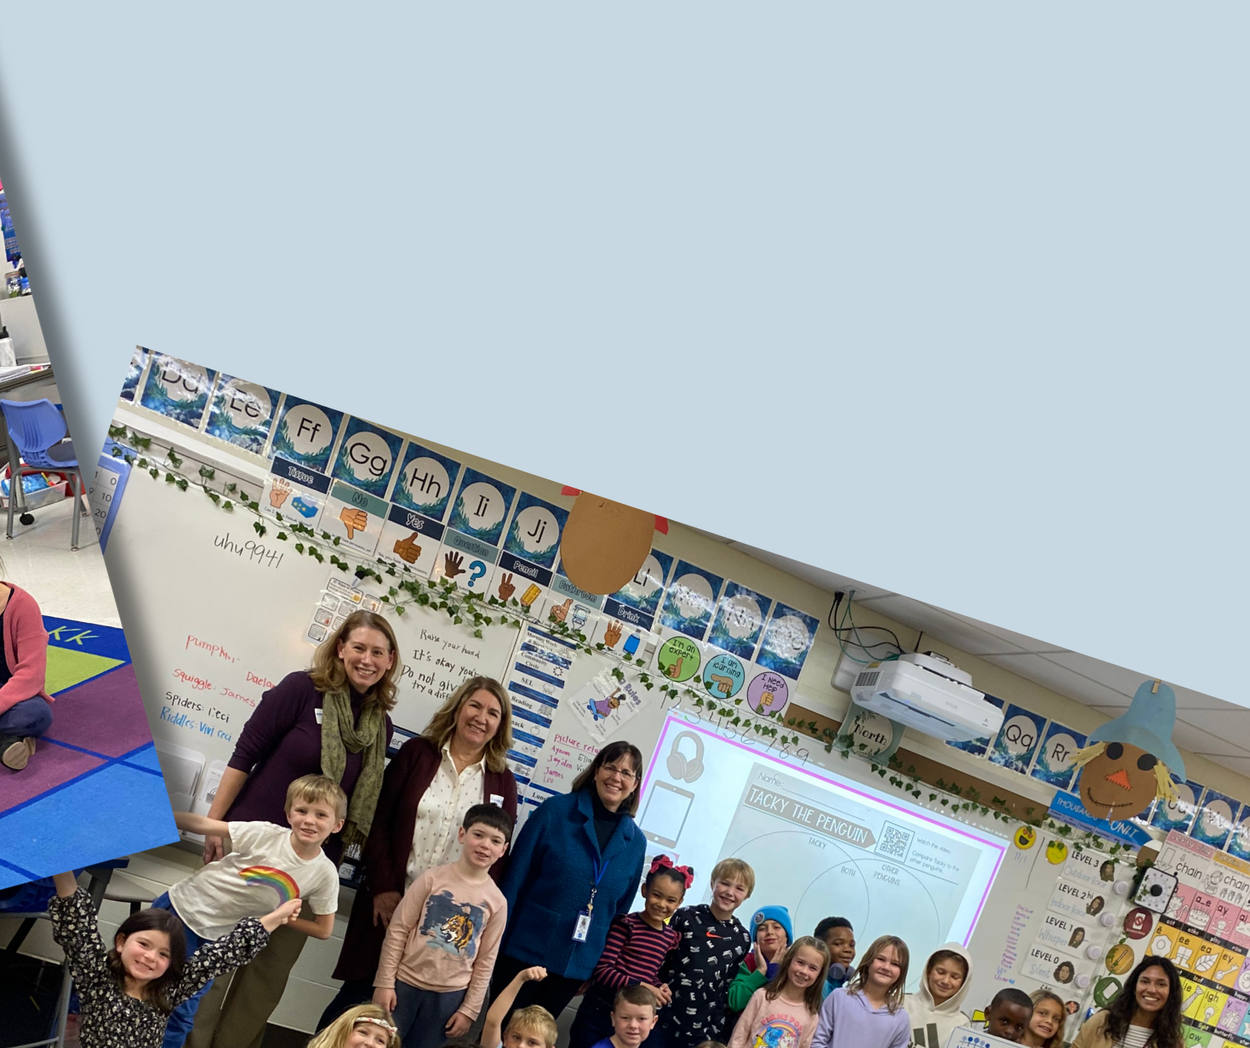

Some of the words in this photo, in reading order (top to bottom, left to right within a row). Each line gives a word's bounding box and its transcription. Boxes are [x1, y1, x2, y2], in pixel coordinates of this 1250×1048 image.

[287, 465, 314, 485] Tissue
[513, 560, 539, 578] Pencil
[297, 415, 322, 443] Ff
[349, 442, 388, 477] Gg
[409, 467, 442, 498] Hh
[474, 494, 489, 518] Ii
[526, 518, 548, 544] Jj
[1006, 723, 1035, 755] Qq
[1050, 742, 1071, 764] Rr
[617, 606, 640, 624] Drink
[420, 629, 440, 643] Raise
[669, 645, 694, 661] expert
[435, 657, 455, 672] okay
[418, 672, 436, 687] not
[853, 721, 888, 747] North
[749, 787, 789, 812] TACKY
[791, 804, 812, 825] THE
[815, 814, 868, 845] PENGUIN
[808, 837, 827, 850] TACKY
[1071, 849, 1092, 865] LEVEL
[840, 865, 856, 877] BOTH
[881, 863, 899, 876] OTHER
[1176, 861, 1203, 880] chain
[873, 871, 901, 886] PENGUINS
[1223, 873, 1250, 892] chain
[1058, 883, 1080, 898] LEVEL
[1045, 915, 1068, 931] LEVEL
[1031, 948, 1053, 963] LEVEL
